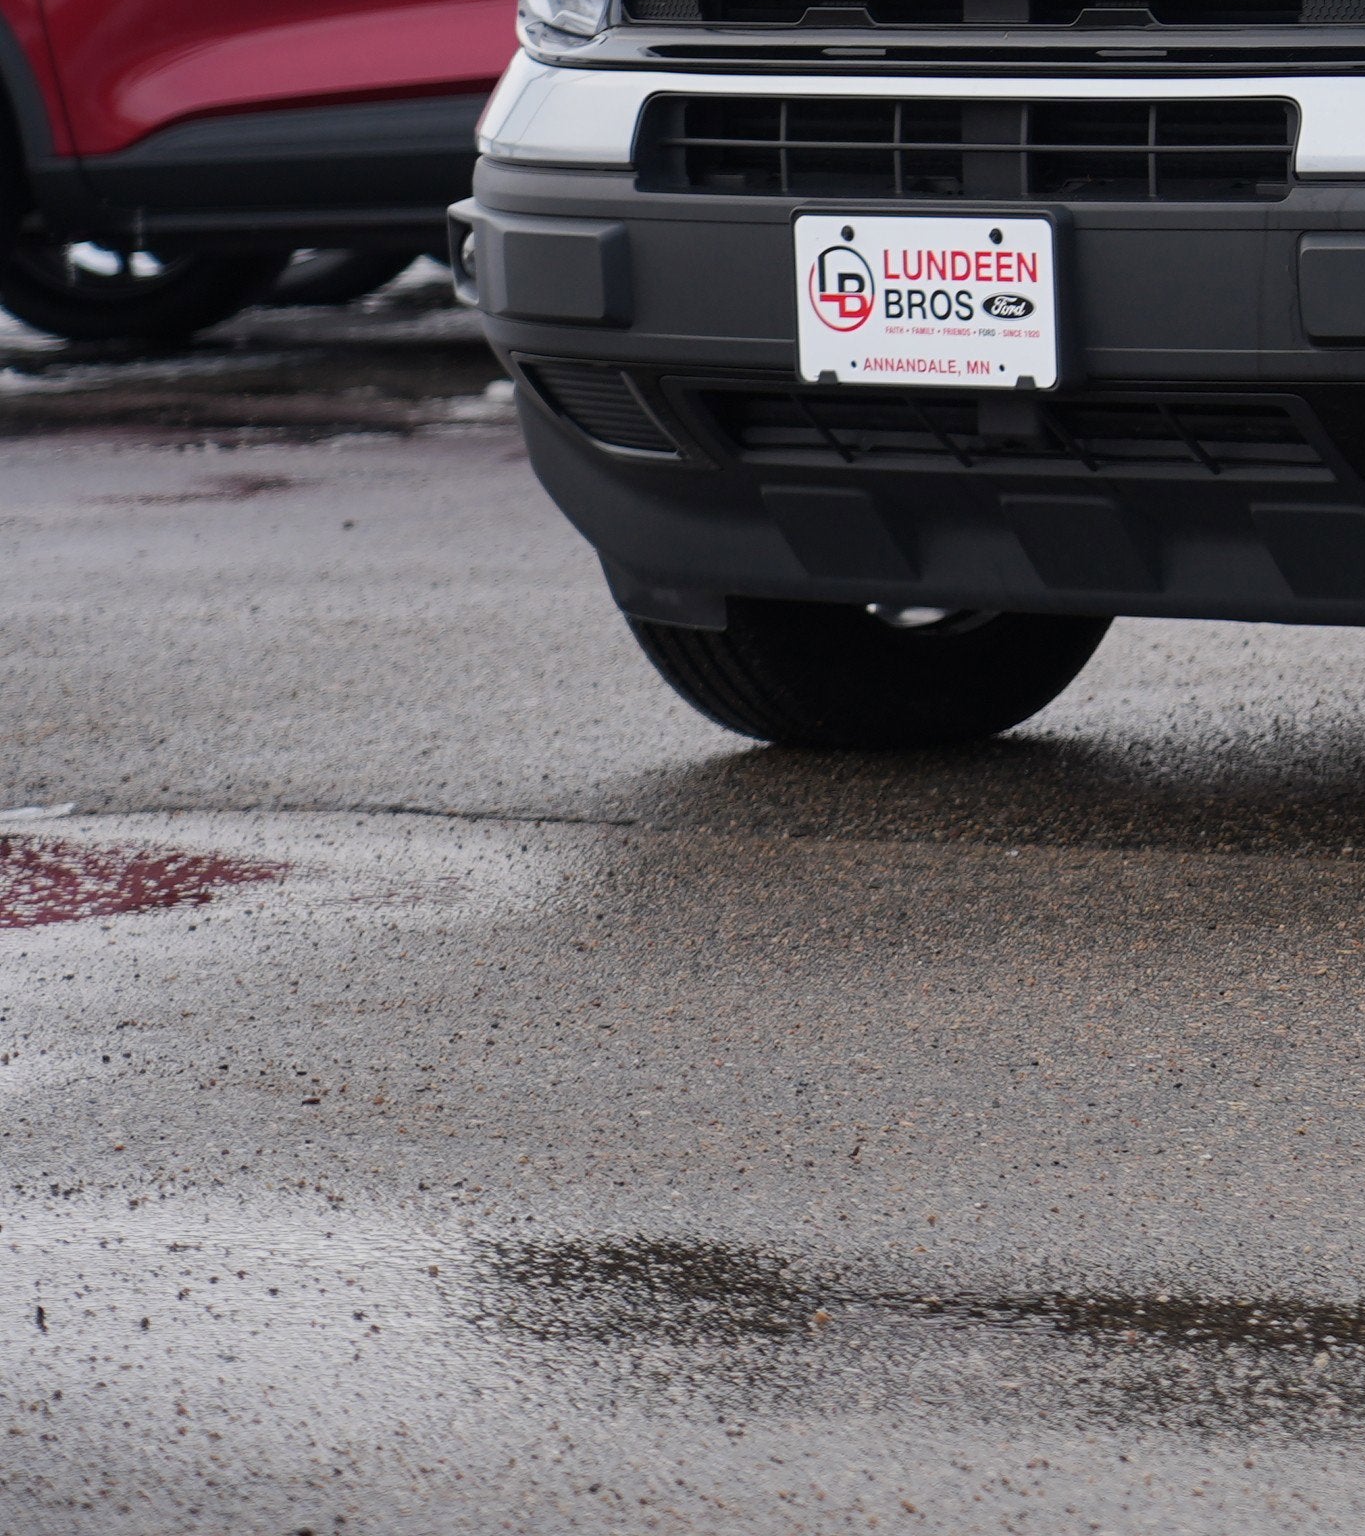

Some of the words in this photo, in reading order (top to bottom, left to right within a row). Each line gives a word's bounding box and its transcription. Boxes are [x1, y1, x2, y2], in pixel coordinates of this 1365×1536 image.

[883, 249, 1039, 283] LUNDEEN
[884, 289, 975, 321] BROS
[863, 356, 962, 376] ANNANDALE,
[966, 359, 991, 375] MN
